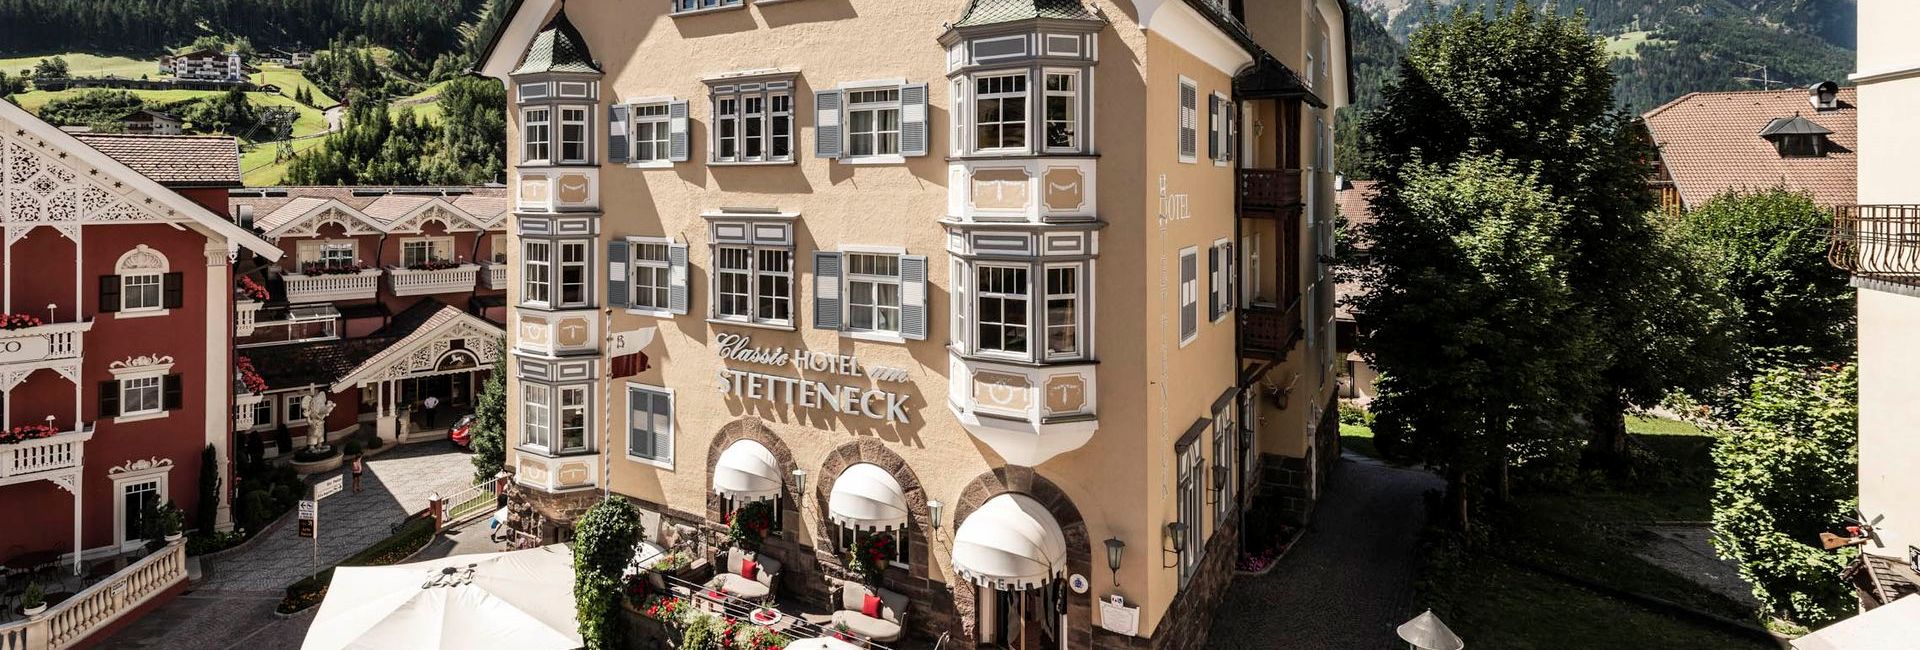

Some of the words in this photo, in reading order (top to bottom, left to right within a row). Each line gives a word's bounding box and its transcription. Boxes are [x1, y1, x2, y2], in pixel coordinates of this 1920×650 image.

[715, 333, 789, 367] Classic
[795, 349, 864, 377] HOTEL
[717, 368, 910, 424] STETTENECK
